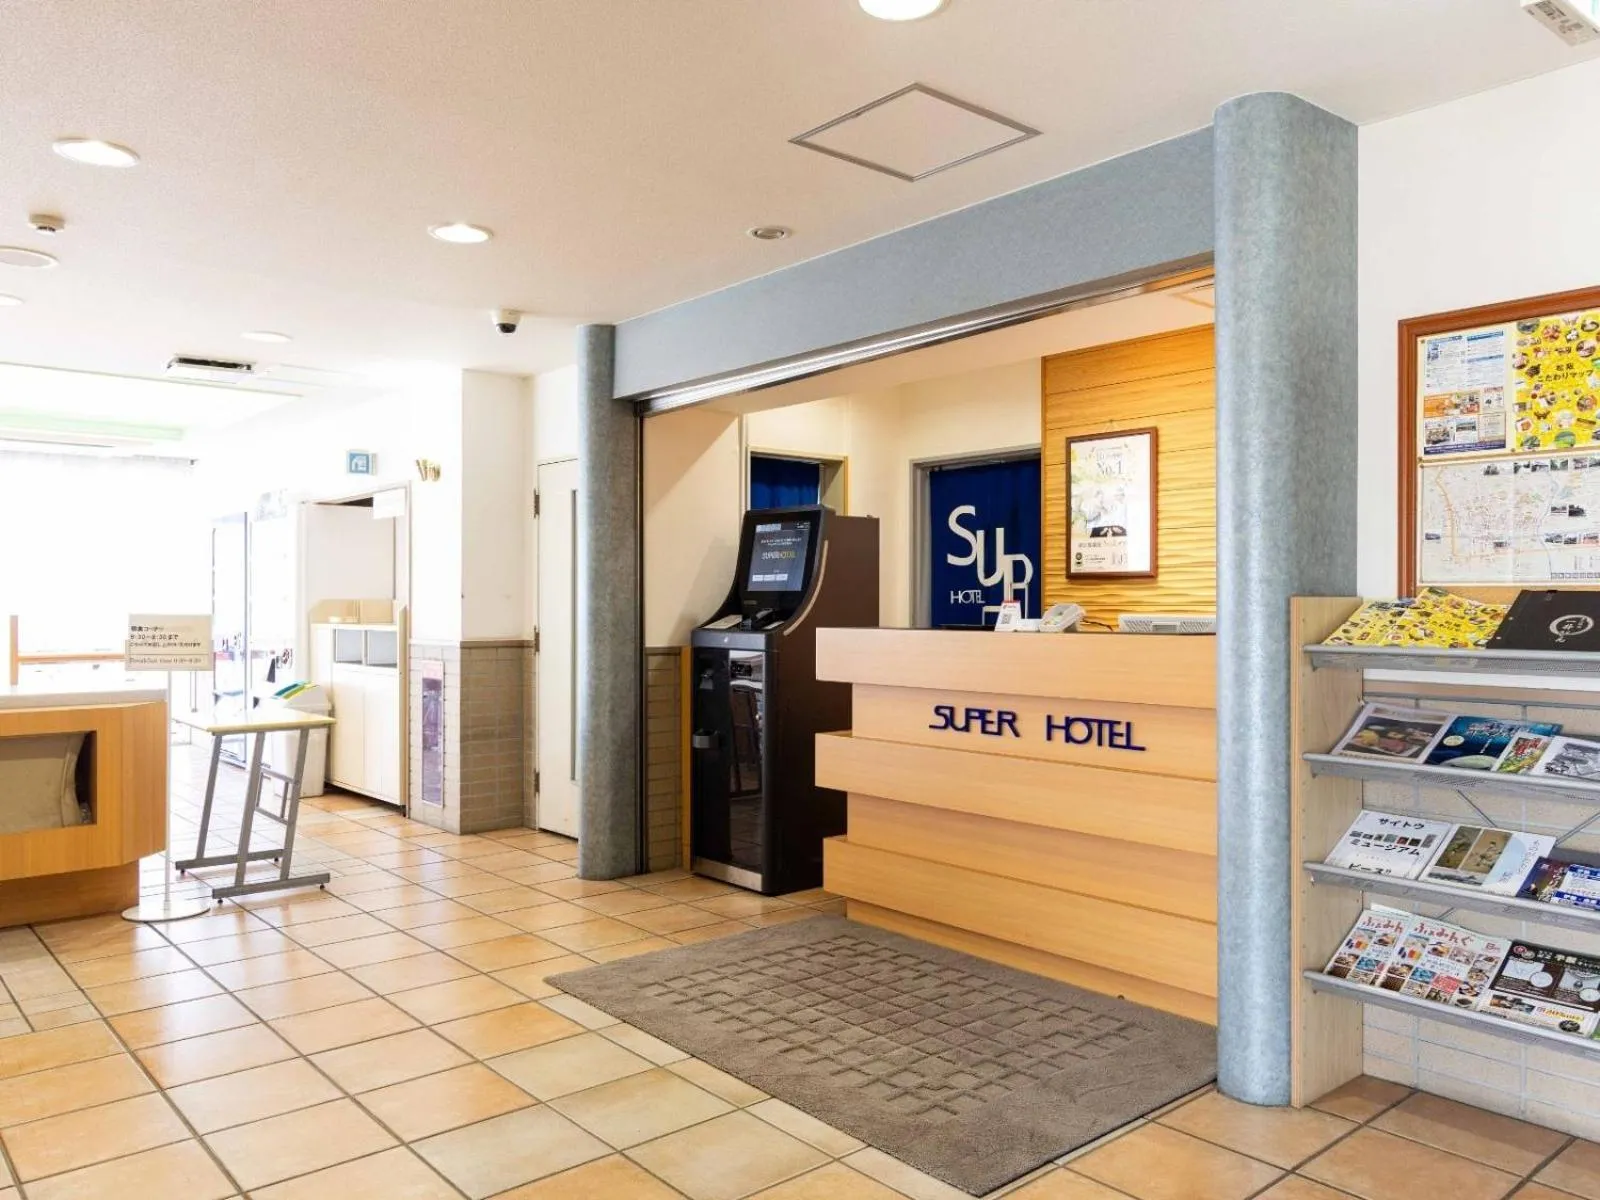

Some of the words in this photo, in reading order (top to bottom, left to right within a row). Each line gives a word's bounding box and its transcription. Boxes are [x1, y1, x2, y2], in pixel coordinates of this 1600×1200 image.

[950, 589, 986, 604] HOTEL
[928, 705, 1021, 738] SUPER
[1046, 714, 1147, 751] HOTEL
[1379, 818, 1425, 830] サイトウ
[1350, 838, 1421, 856] ミュージアム
